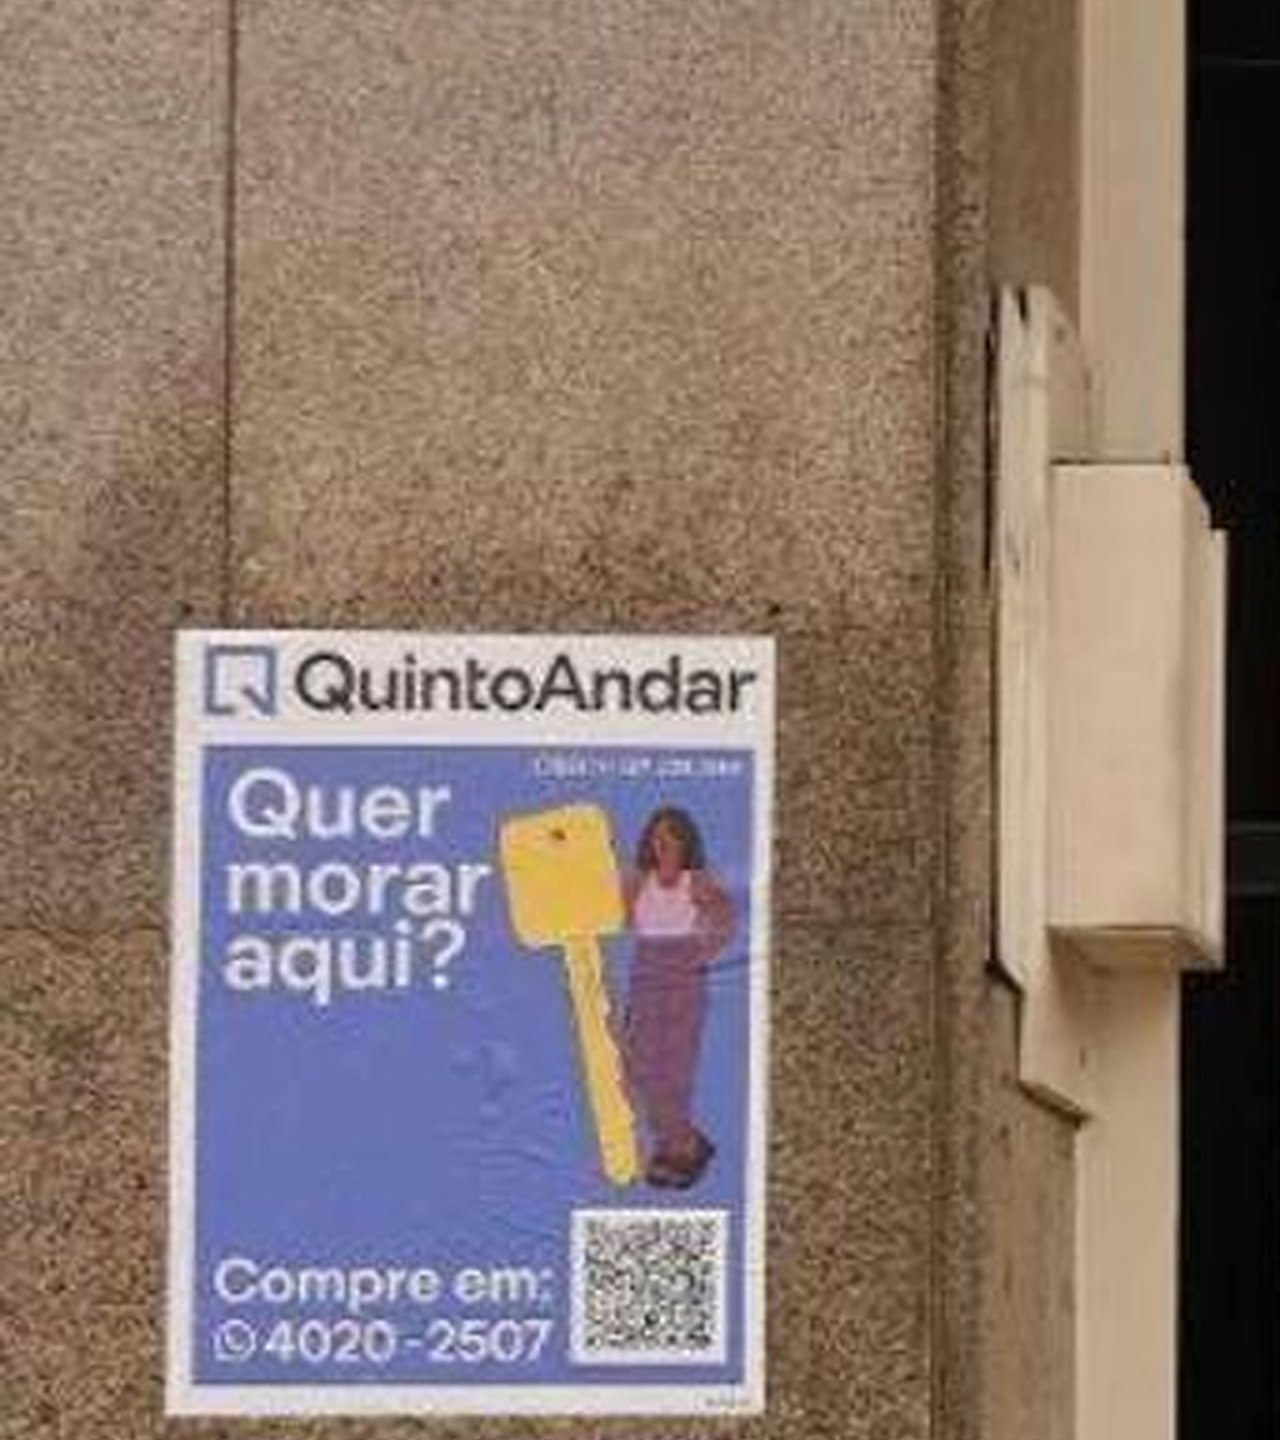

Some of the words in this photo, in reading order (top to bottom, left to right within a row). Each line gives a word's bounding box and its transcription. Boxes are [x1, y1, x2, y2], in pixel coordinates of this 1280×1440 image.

[295, 652, 757, 714] QuintoAndar
[227, 767, 451, 839] Quer
[225, 859, 492, 915] morar
[224, 919, 467, 1007] aqui?
[214, 1258, 441, 1312] Compre
[454, 1264, 556, 1304] em:
[263, 1318, 556, 1363] 4020-2507
